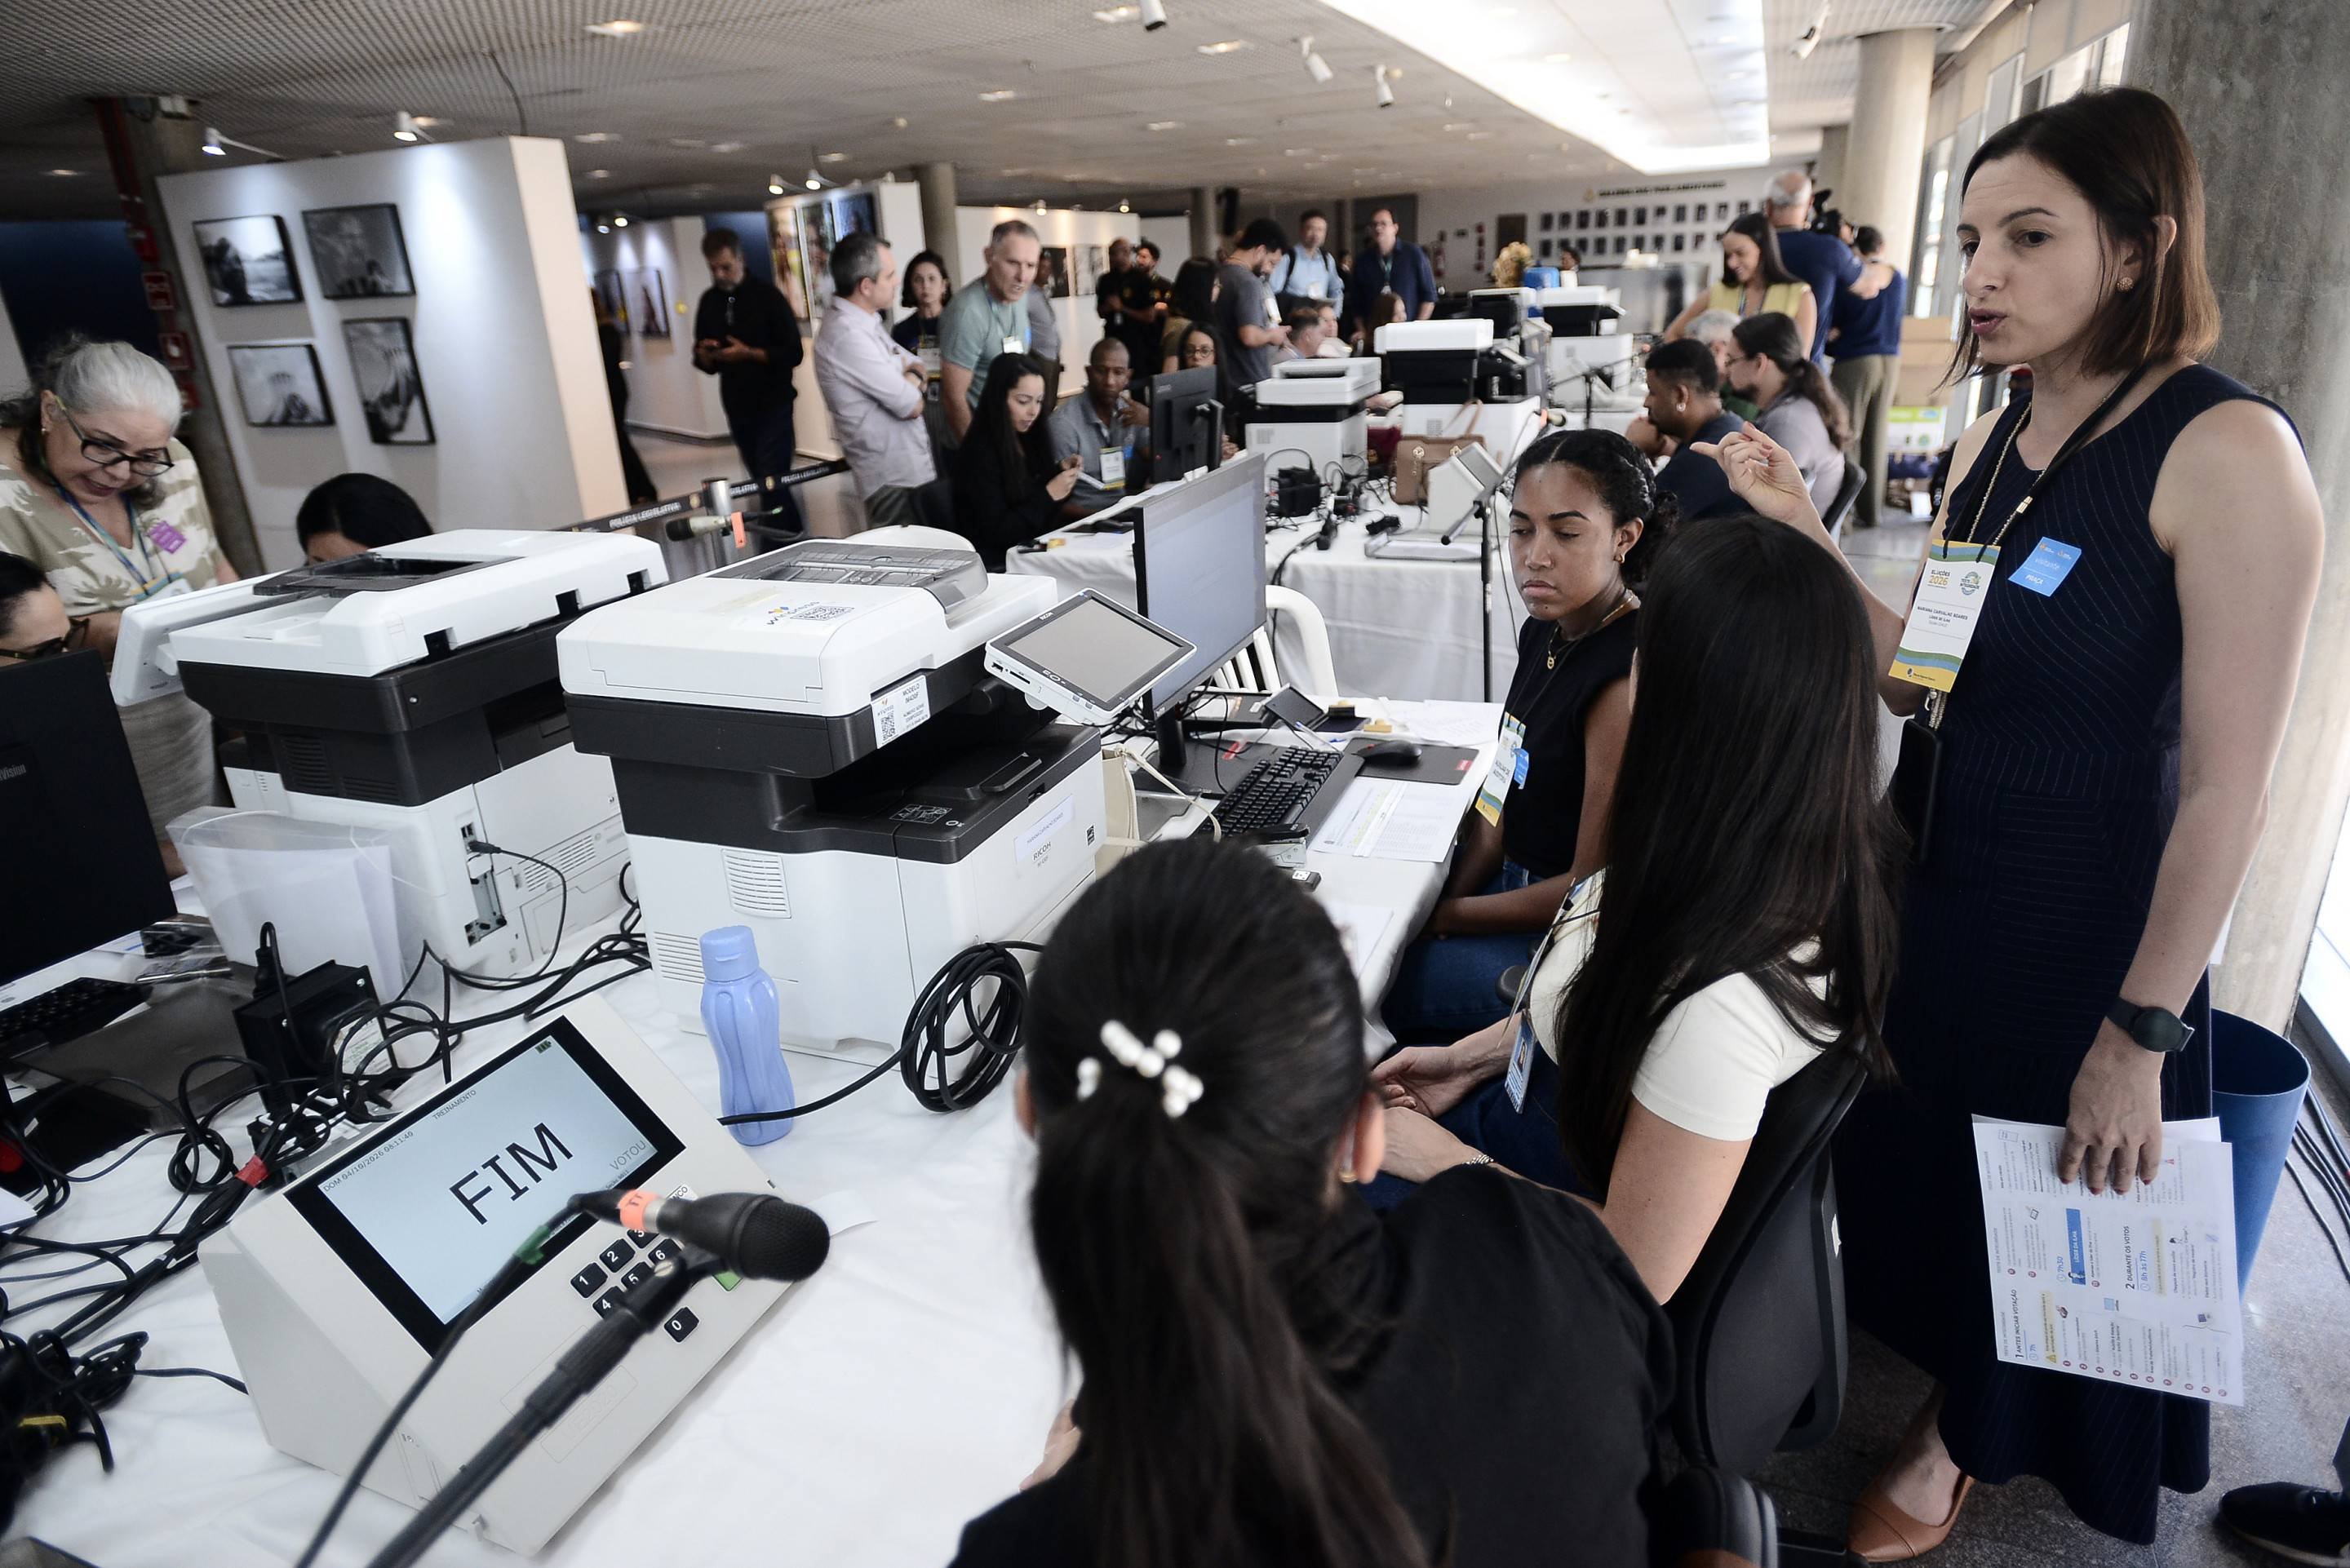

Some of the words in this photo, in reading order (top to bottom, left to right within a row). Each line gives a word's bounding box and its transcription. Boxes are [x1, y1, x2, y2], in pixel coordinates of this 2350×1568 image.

[1928, 575, 1949, 586] 2026
[0, 764, 26, 781] Vision
[1033, 841, 1051, 861] RICOH
[432, 1089, 477, 1121] TREINAMENTO
[323, 1177, 343, 1192] DOM
[342, 1150, 384, 1181] 04/10/2026
[384, 1131, 414, 1152] 08:11:40
[610, 1140, 646, 1172] VOTOU
[449, 1122, 574, 1225] FIM
[655, 1250, 666, 1260] 6
[2125, 1245, 2131, 1253] OS
[606, 1251, 619, 1263] 2
[579, 1275, 588, 1286] 1
[627, 1273, 639, 1284] 5
[602, 1299, 611, 1310] 4
[2011, 1289, 2019, 1315] VOTAÇÃO
[672, 1319, 682, 1331] 0
